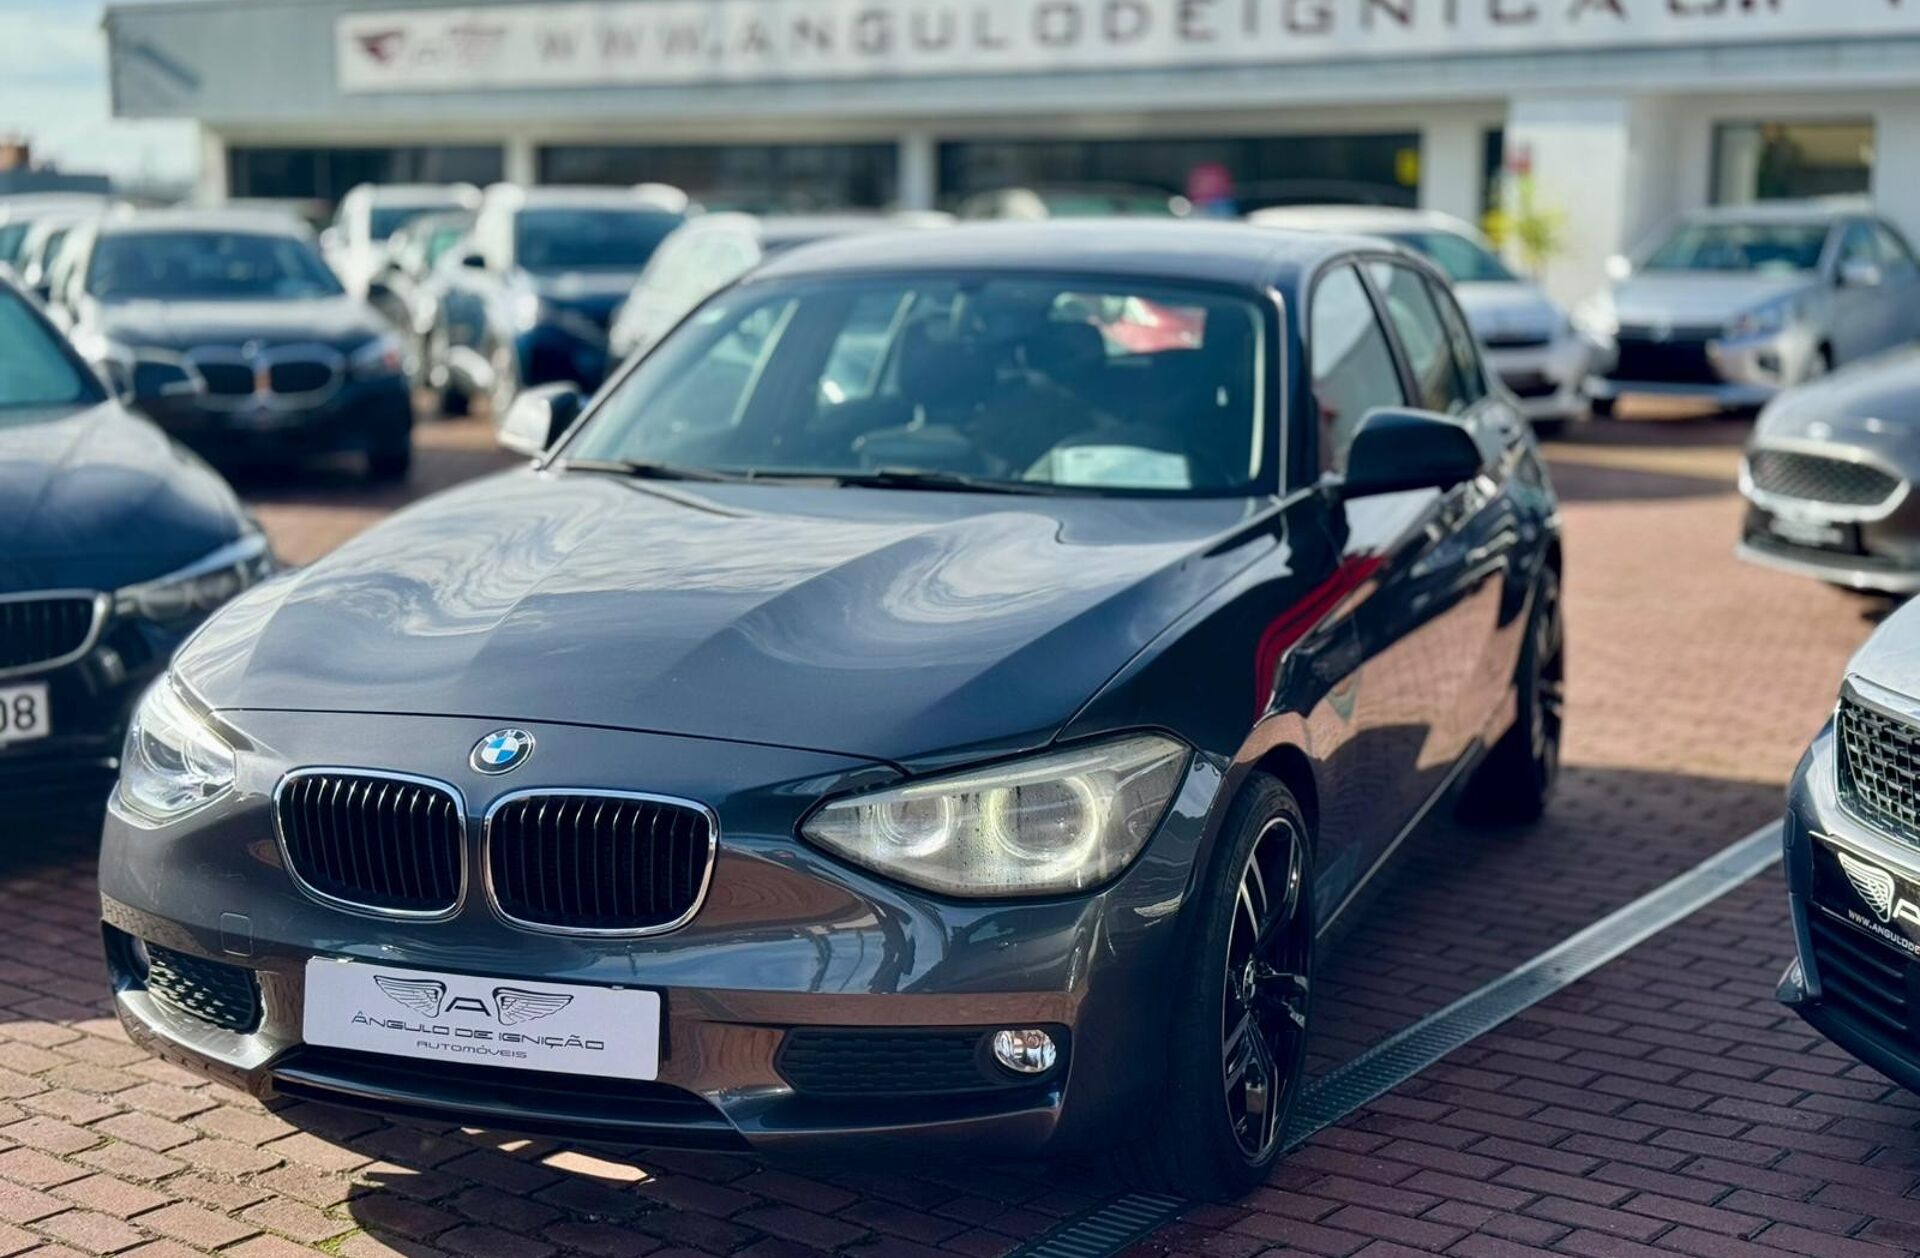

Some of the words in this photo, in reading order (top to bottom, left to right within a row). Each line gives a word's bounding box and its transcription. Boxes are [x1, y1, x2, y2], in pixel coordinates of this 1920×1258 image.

[351, 1010, 450, 1036] ÂNGULO
[455, 1028, 493, 1040] DE
[499, 1032, 605, 1050] IGNIÇÃO
[416, 1040, 528, 1059] AUTOMÓVEIS
